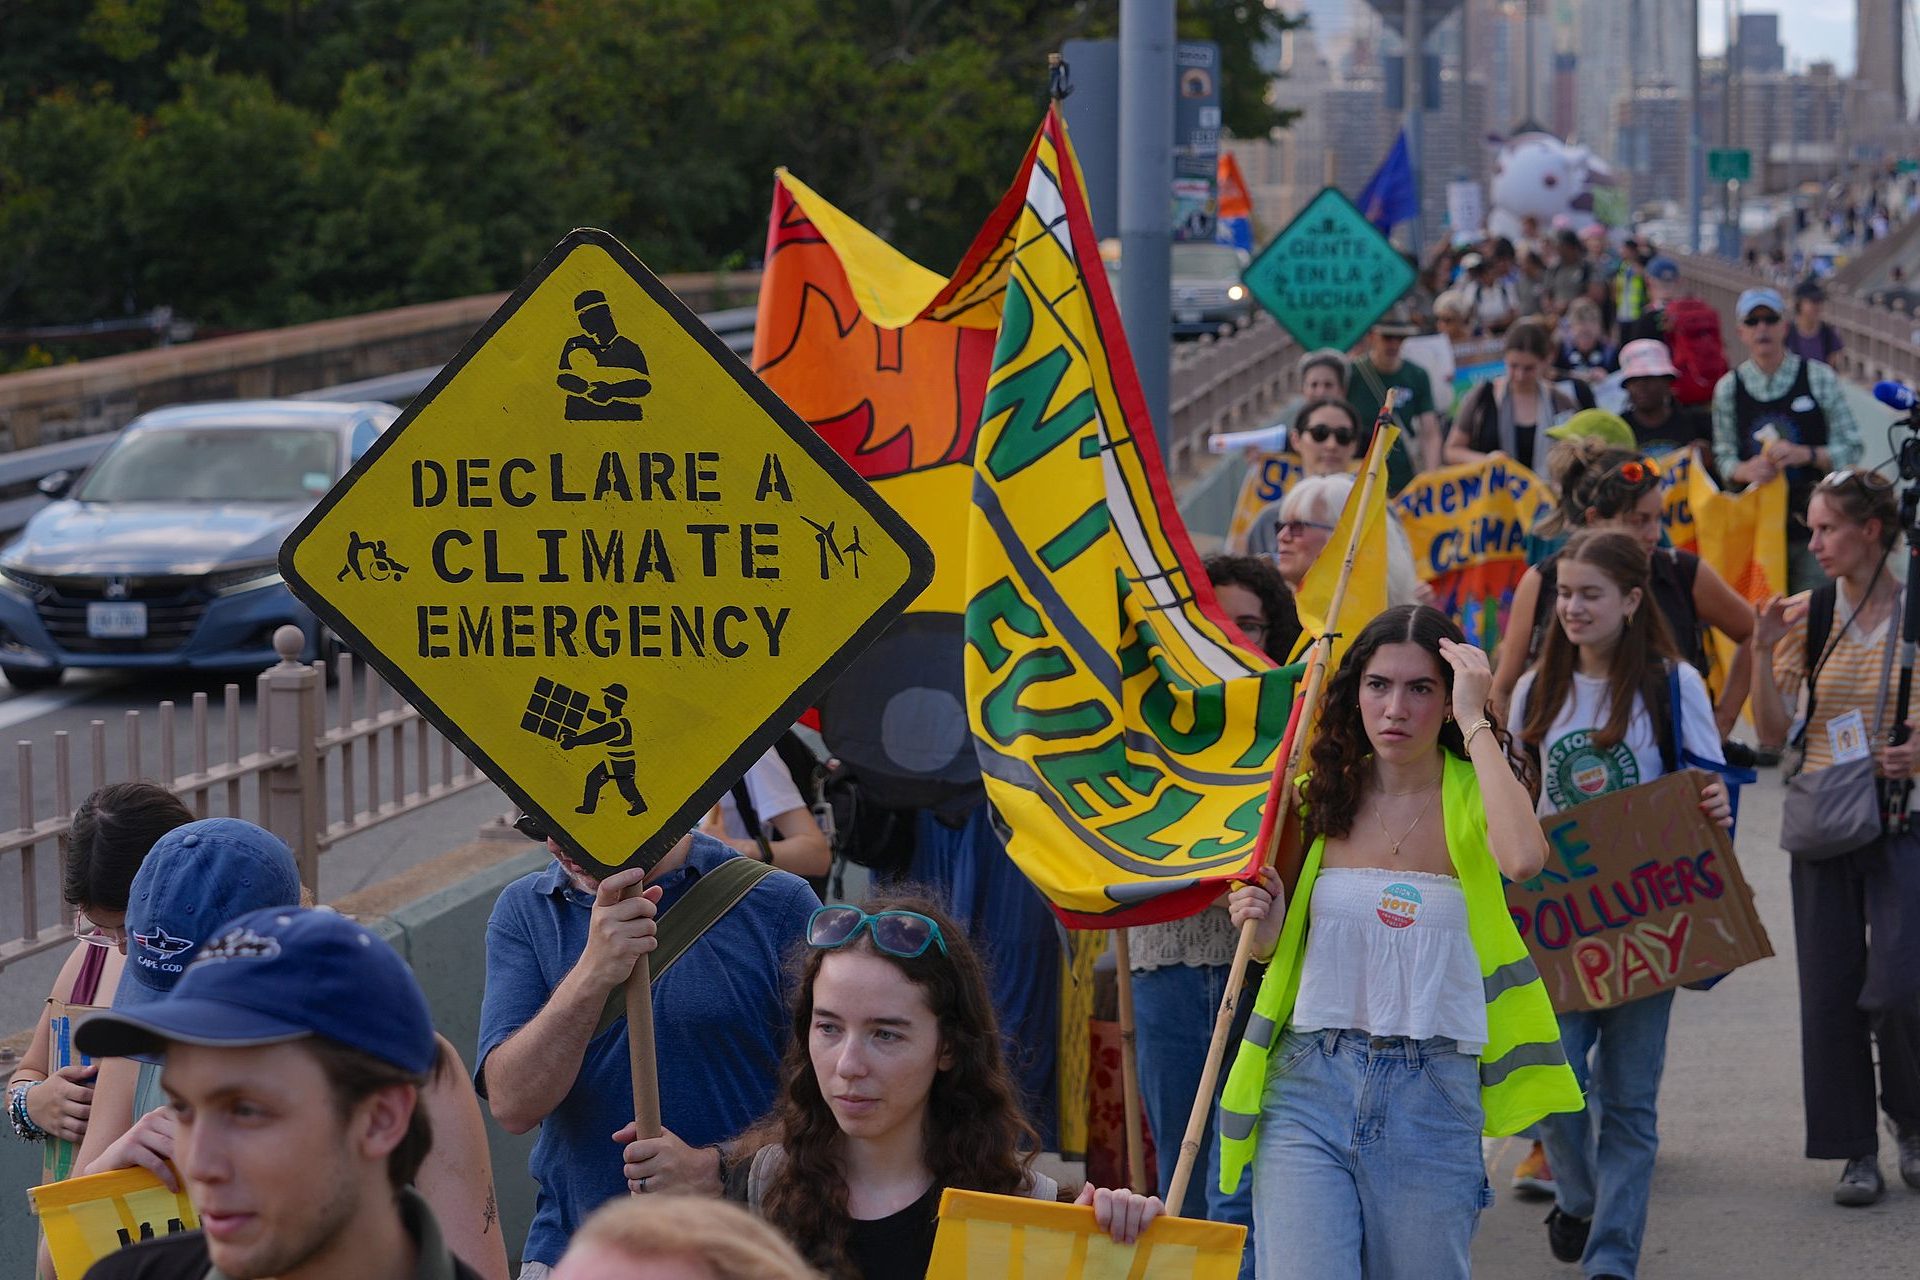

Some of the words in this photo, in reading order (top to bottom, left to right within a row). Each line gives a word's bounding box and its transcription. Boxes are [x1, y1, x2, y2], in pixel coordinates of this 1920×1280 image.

[1287, 290, 1368, 310] LUCHA
[411, 452, 721, 508] DECLARE
[756, 453, 793, 502] A
[431, 523, 780, 583] CLIMATE
[417, 604, 792, 659] EMERGENCY
[1381, 897, 1418, 914] VOTE
[138, 955, 159, 969] CAPE
[161, 963, 183, 973] COD
[1572, 912, 1692, 1008] PAY
